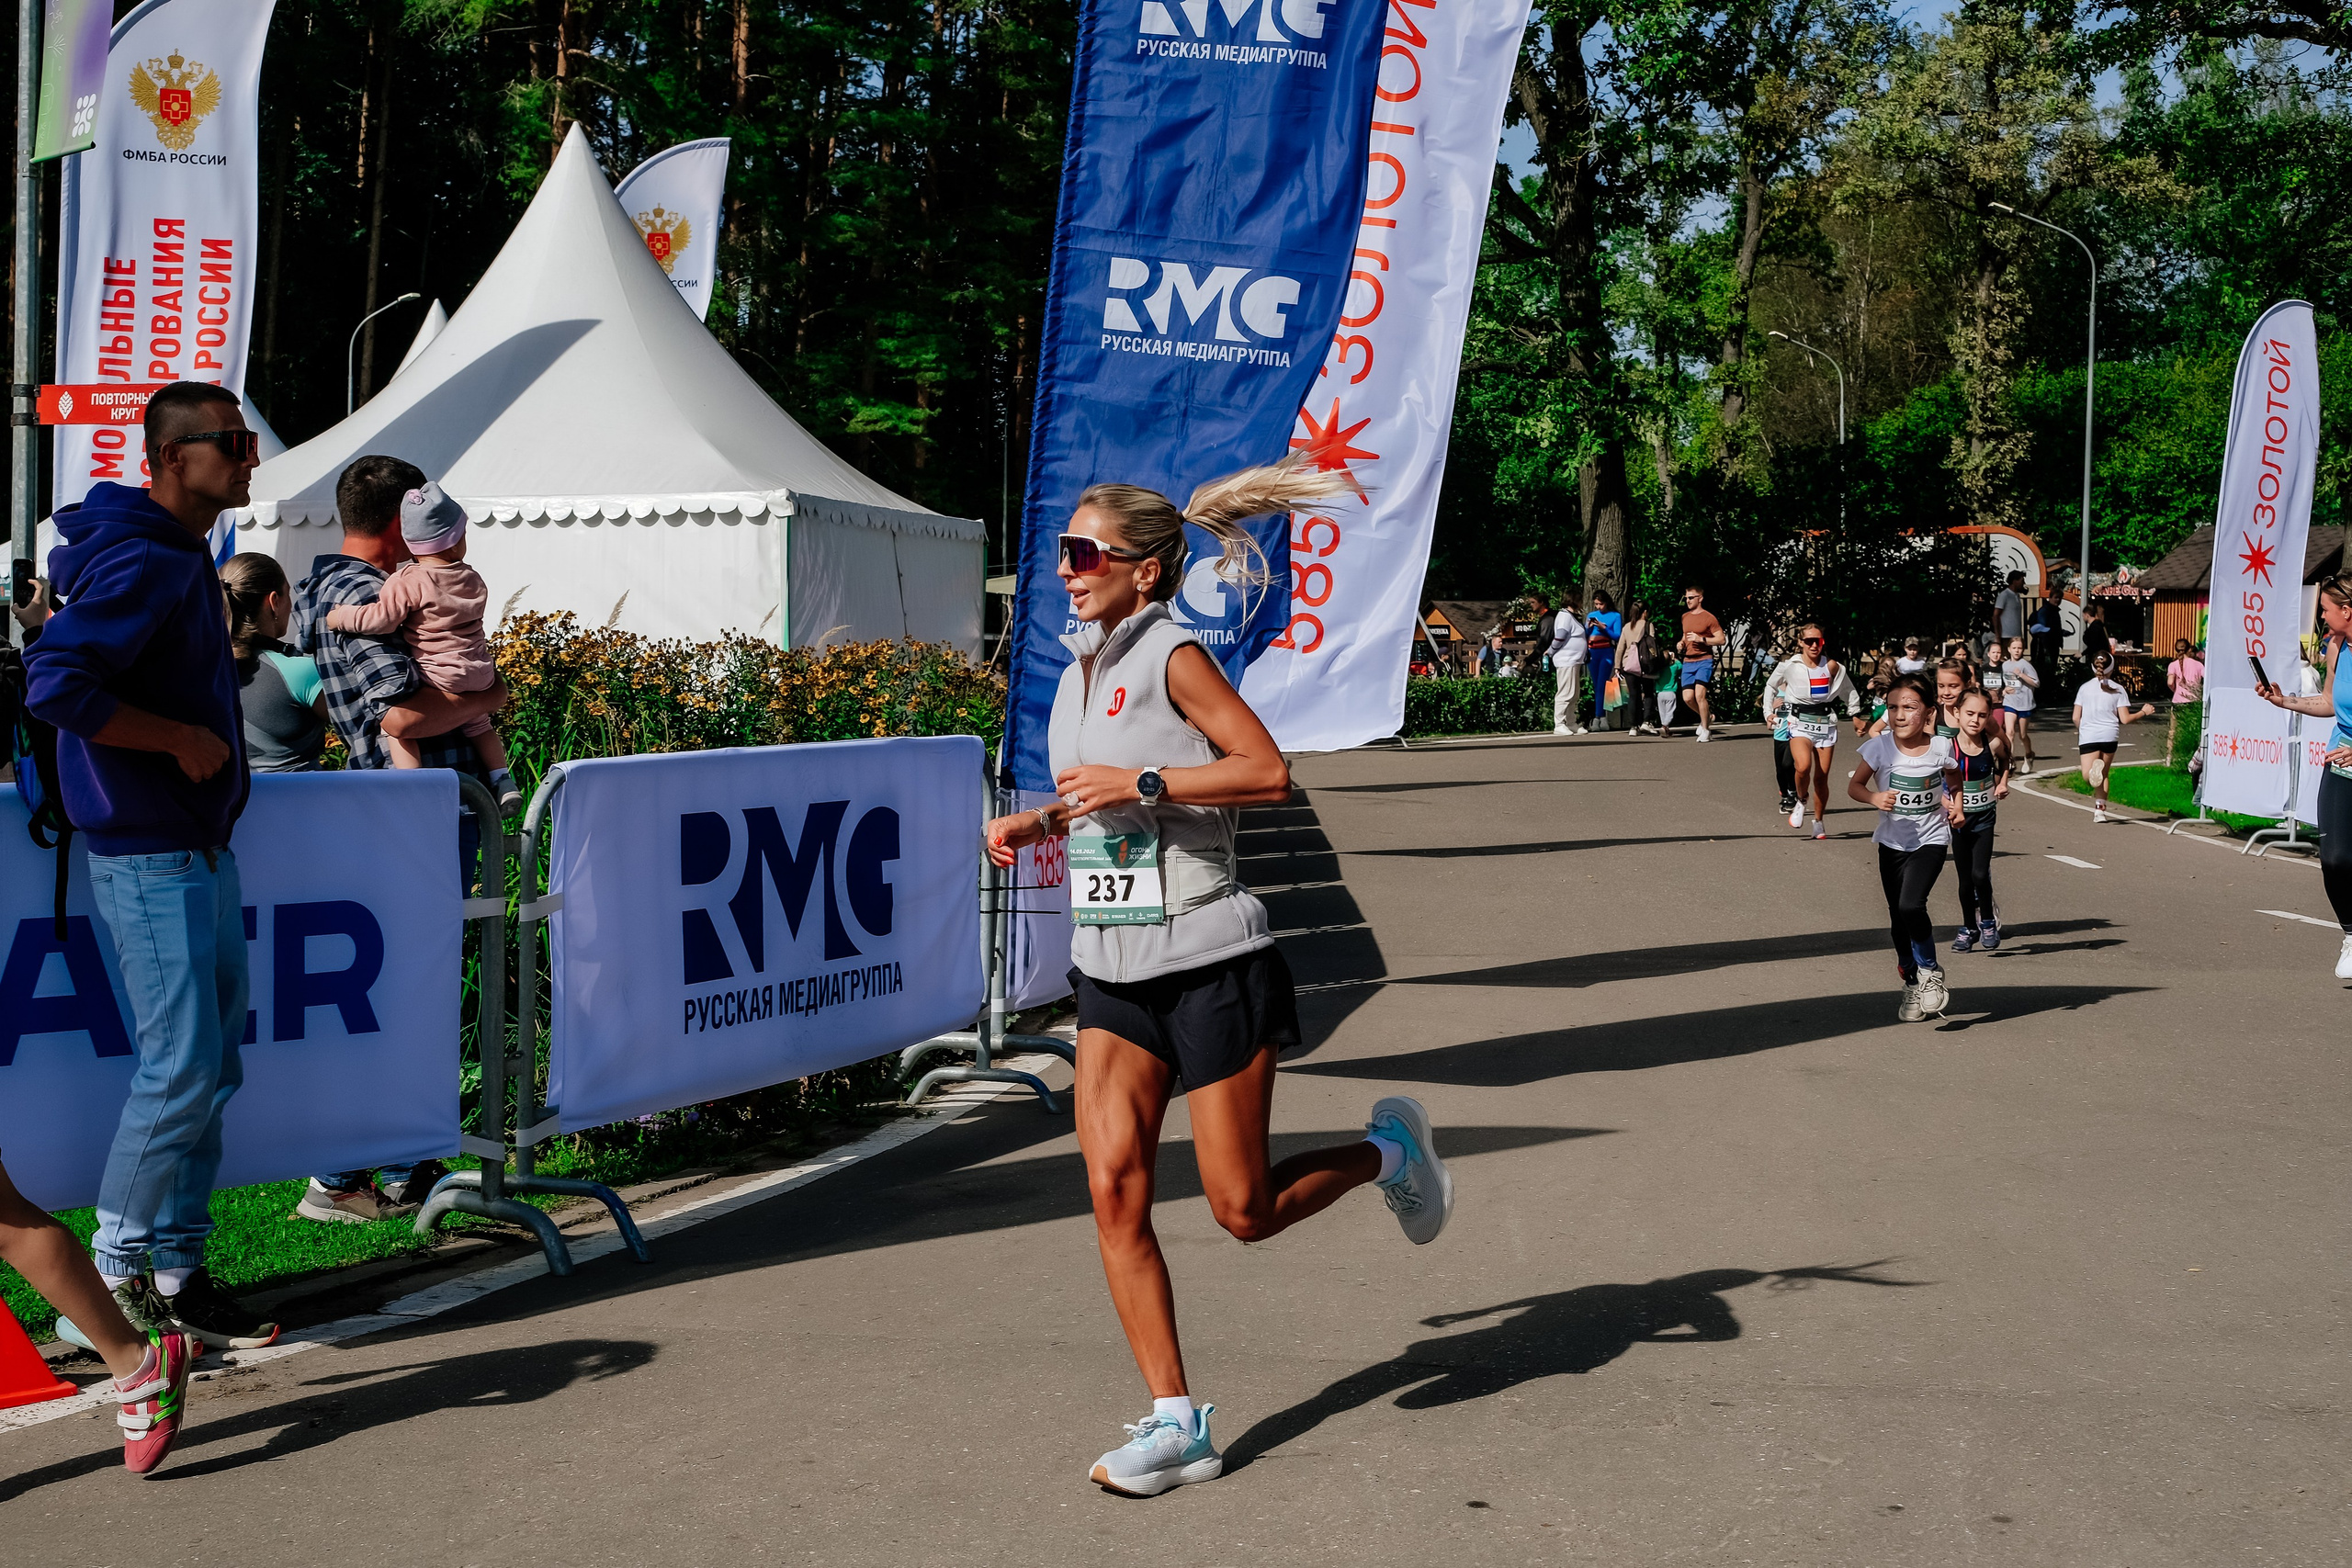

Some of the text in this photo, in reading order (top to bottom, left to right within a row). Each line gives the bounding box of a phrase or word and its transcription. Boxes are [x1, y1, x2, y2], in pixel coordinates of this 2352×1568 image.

[1136, 39, 1328, 69] РУССКАЯ МЕДИАГРУППА
[122, 149, 227, 166] ФМБА РОССИИ
[672, 279, 698, 288] ССИИ
[194, 238, 233, 369] РОССИИ
[1103, 257, 1301, 343] RMG
[1101, 334, 1291, 367] РУССКАЯ МЕДИАГРУППА
[89, 256, 137, 478] МОЛЬНЫЕ
[90, 390, 158, 406] ПОВТОРНЫ
[110, 407, 140, 420] КРУГ
[2243, 338, 2291, 660] 585 ЗОЛОТОЙ
[1270, 512, 1341, 655] 585
[1804, 724, 1822, 732] 234
[2213, 734, 2283, 765] 585 ЗОЛОТОЙ
[2309, 740, 2326, 767] 585
[1899, 792, 1934, 807] 649
[1962, 793, 1989, 805] 656
[1035, 835, 1064, 890] 585
[681, 800, 900, 986] RMG
[1088, 874, 1135, 903] 237
[684, 961, 903, 1035] РУССКАЯ МЕДИАГРУППА
